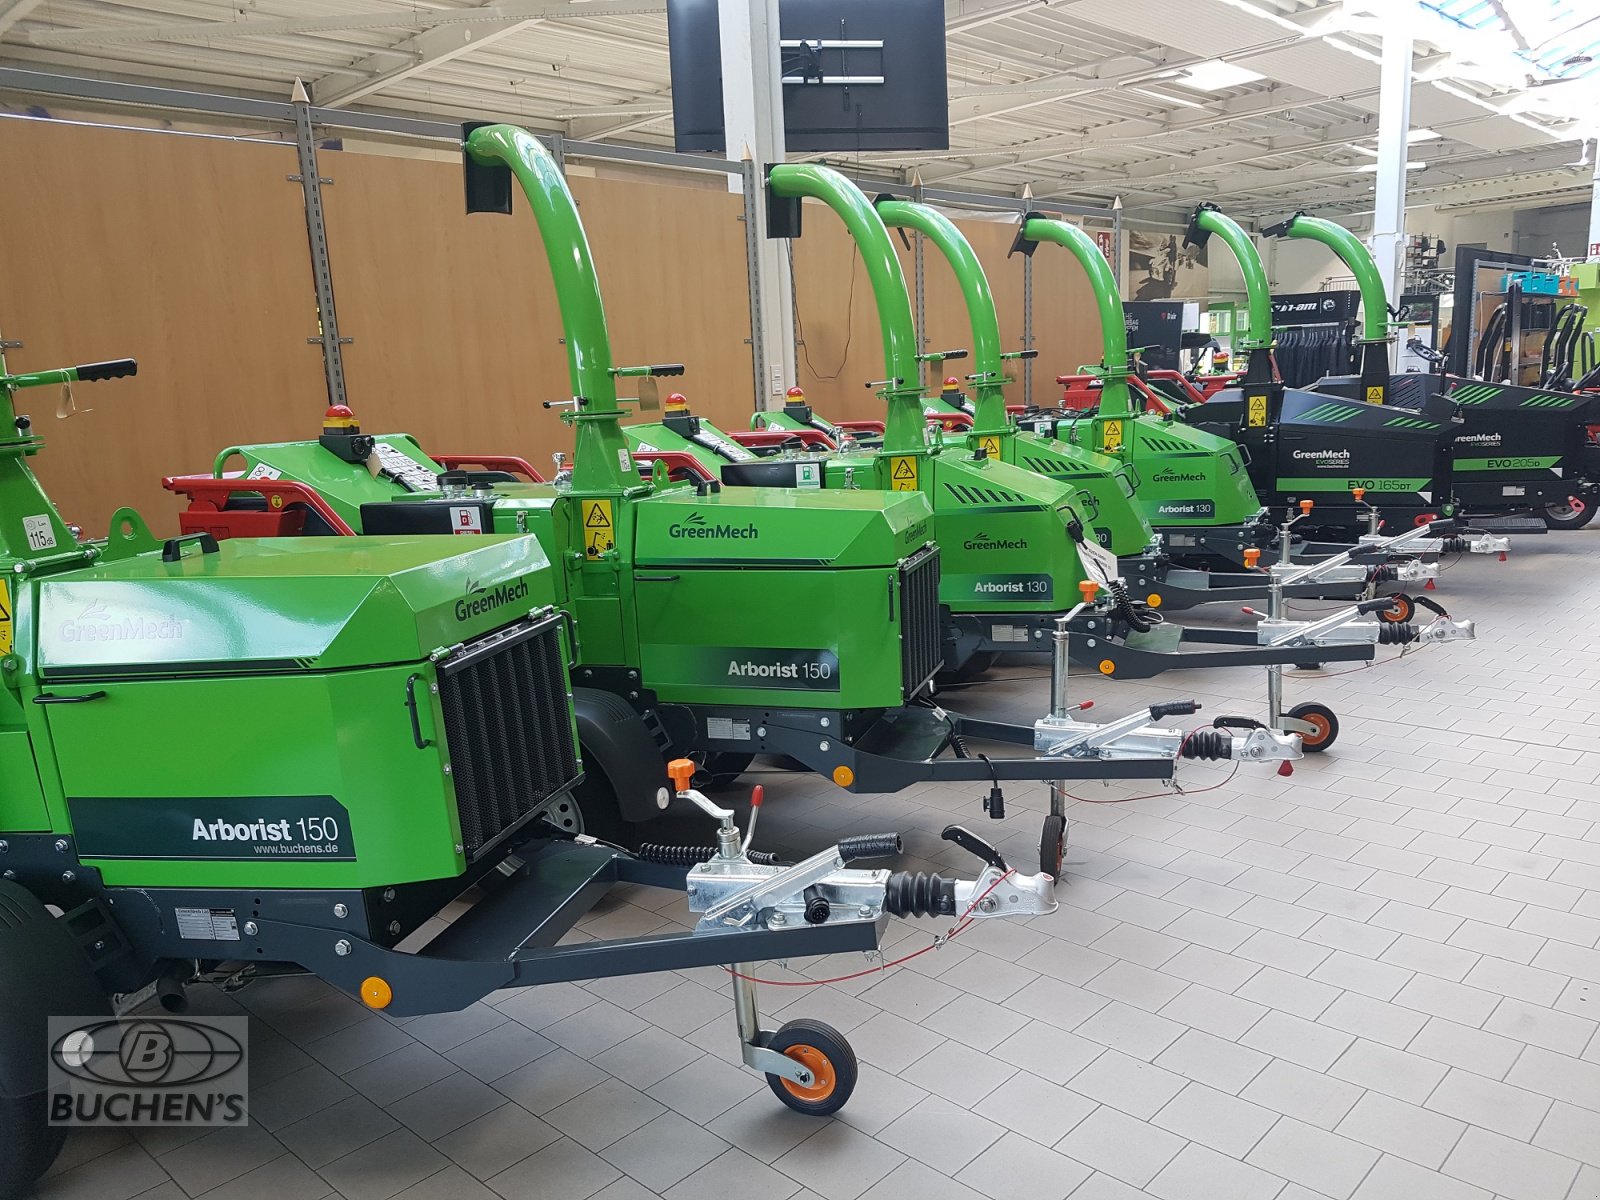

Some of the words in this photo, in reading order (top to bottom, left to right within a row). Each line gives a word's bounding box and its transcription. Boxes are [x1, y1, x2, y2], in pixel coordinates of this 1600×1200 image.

[1293, 449, 1350, 459] GreenMech
[1487, 460, 1511, 468] EVO
[1152, 472, 1206, 482] GreenMech
[1347, 480, 1375, 490] EVO
[1158, 505, 1194, 513] Arborist
[1196, 504, 1211, 513] 130
[669, 523, 759, 539] GreenMech
[963, 538, 1027, 550] GreenMech
[974, 582, 1024, 593] Arborist
[1026, 581, 1048, 593] 130
[455, 576, 529, 622] GreenMech
[60, 615, 183, 641] GreenMech
[728, 660, 798, 678] Arborist
[802, 662, 831, 679] 150
[192, 818, 292, 841] Arborist
[296, 816, 339, 841] 150
[254, 843, 338, 854] www.buchens.de
